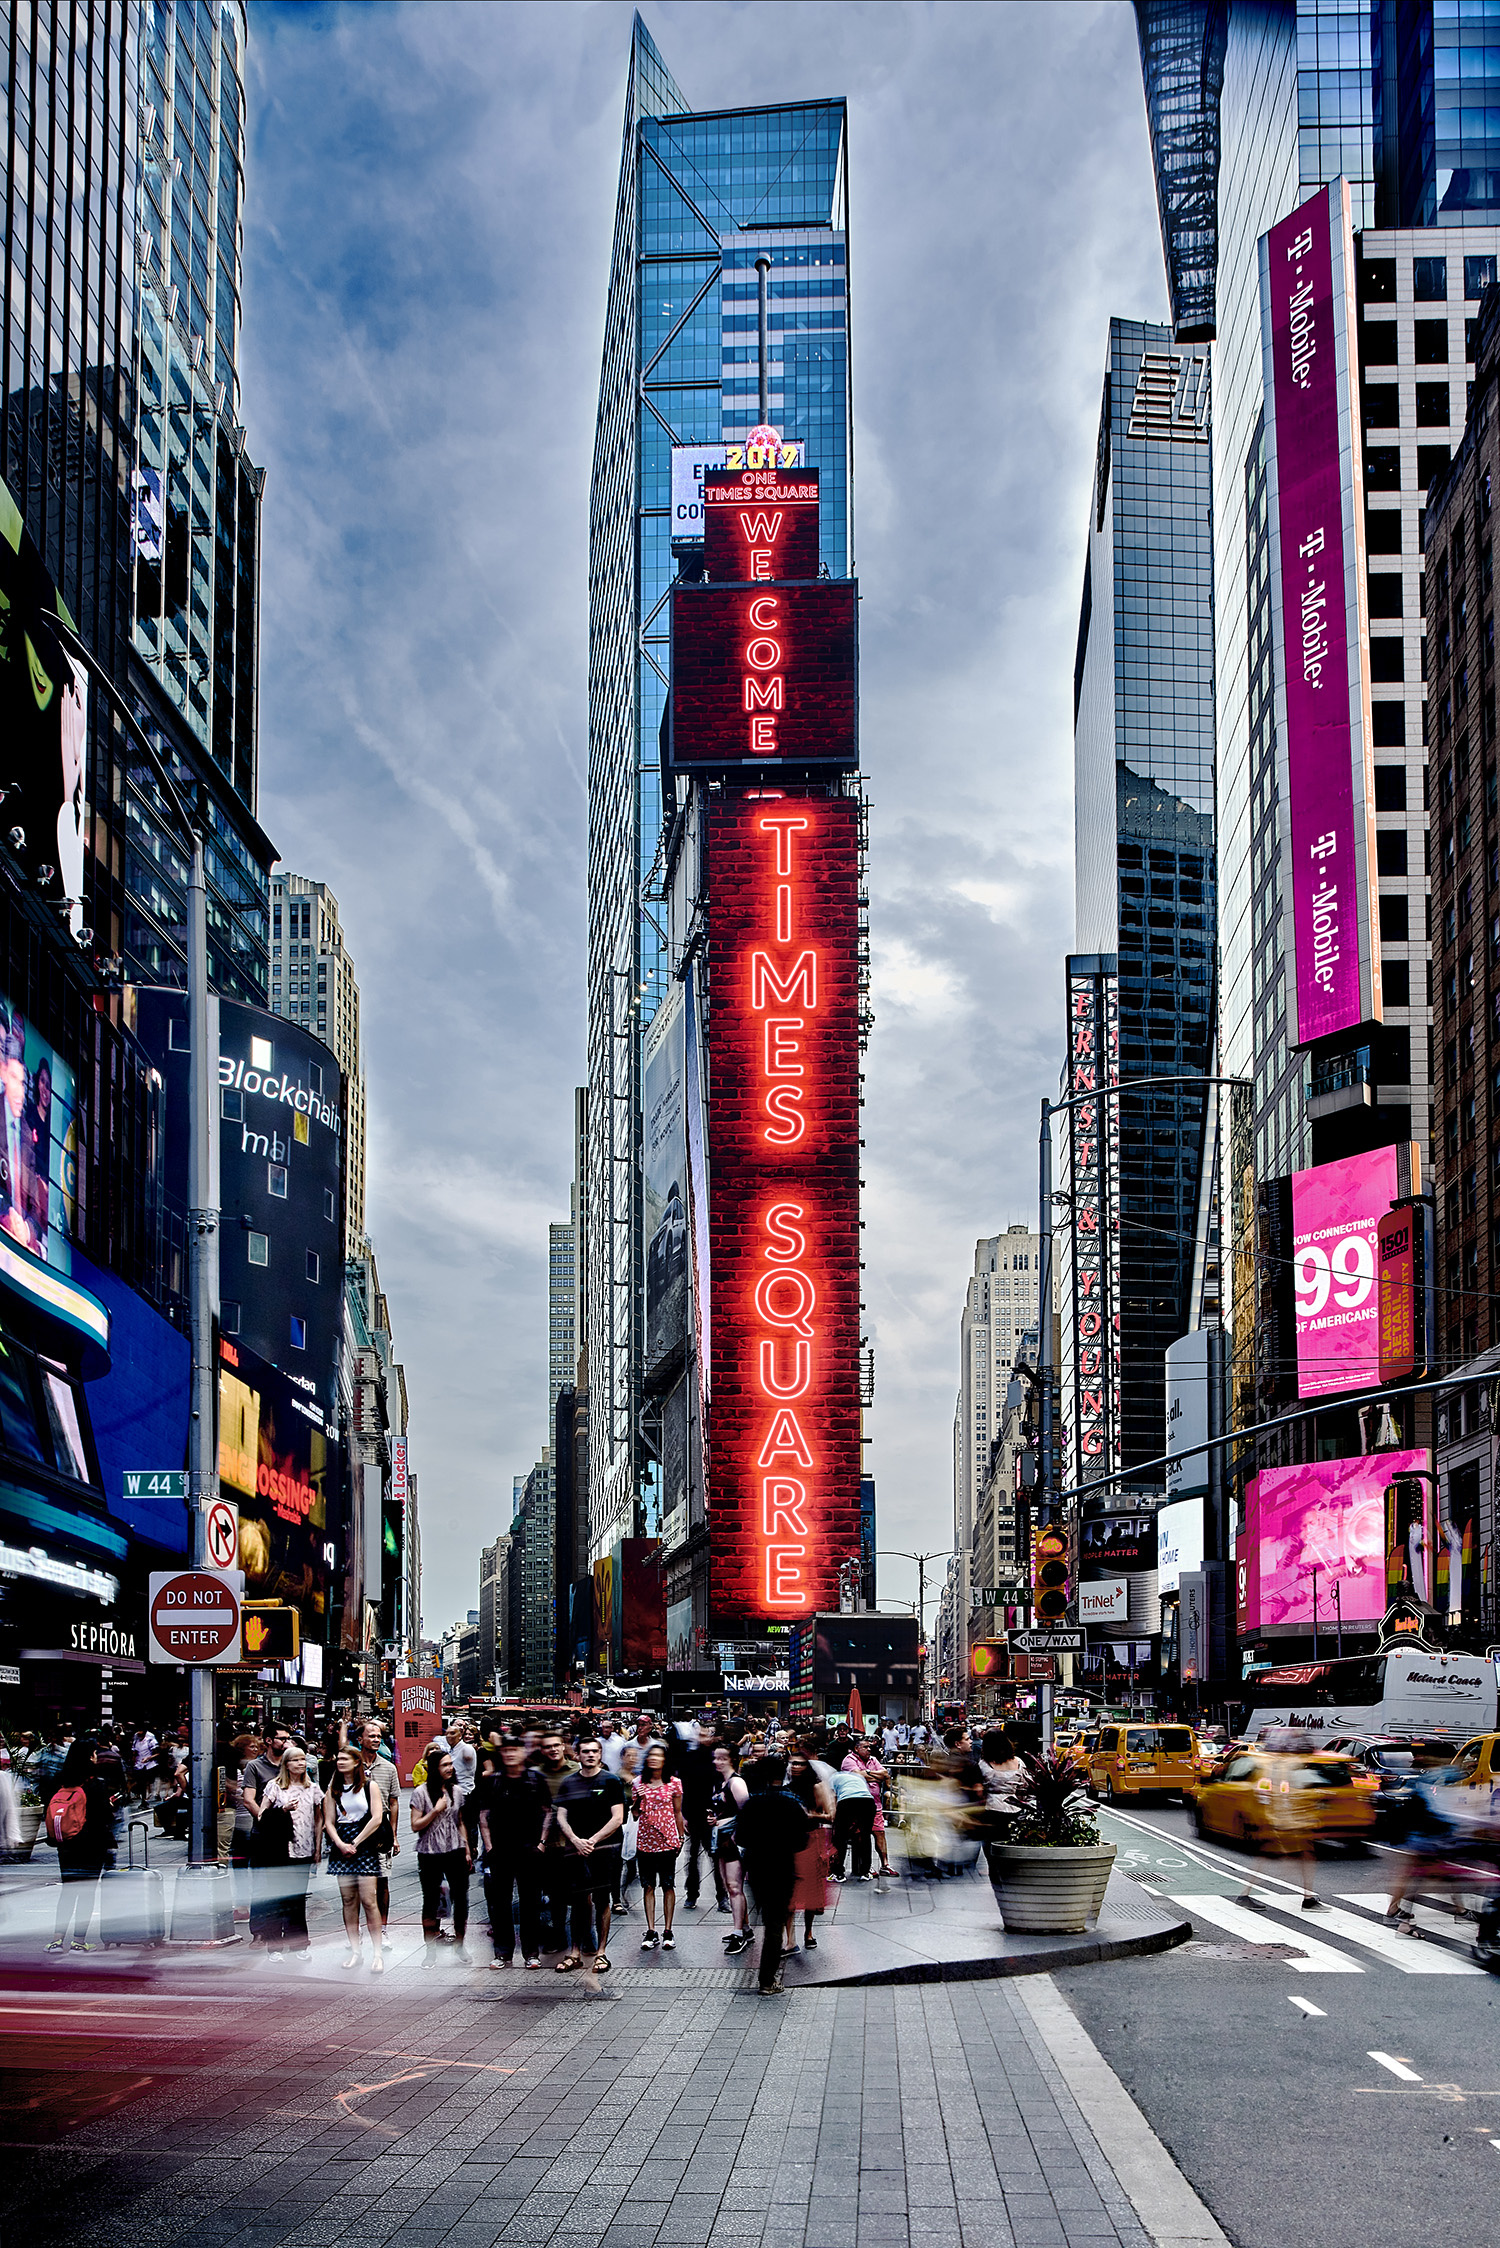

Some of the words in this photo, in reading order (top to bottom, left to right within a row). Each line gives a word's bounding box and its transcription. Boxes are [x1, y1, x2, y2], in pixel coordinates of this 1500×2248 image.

[742, 472, 777, 485] ONE
[706, 487, 753, 501] TIMES
[754, 485, 818, 500] SQUARE
[752, 818, 817, 1145] TIMES
[1075, 993, 1095, 1166] ERNST
[218, 1056, 342, 1136] Blockchain
[1077, 1206, 1097, 1231] &
[1312, 1217, 1376, 1241] CONNECTING
[1380, 1226, 1409, 1254] 1501
[1309, 1307, 1378, 1332] AMERICANS
[1382, 1269, 1392, 1364] FLAGSHIP
[1402, 1262, 1410, 1357] OPPORTUNITY
[1392, 1293, 1402, 1361] RETAIL
[1079, 1271, 1104, 1455] YOUNG
[755, 1203, 816, 1604] SQUARE
[393, 1442, 406, 1488] Locker
[127, 1475, 141, 1494] W
[147, 1475, 171, 1494] 44
[1104, 1549, 1139, 1557] MATTER
[166, 1591, 187, 1605] DO
[193, 1590, 223, 1604] NOT
[985, 1590, 996, 1604] W
[1002, 1590, 1019, 1604] 44
[1081, 1594, 1115, 1610] TriNet
[1348, 1622, 1373, 1631] REUTERS
[71, 1623, 136, 1657] SEPHORA
[170, 1630, 219, 1645] ENTER
[1020, 1636, 1042, 1646] ONE
[1052, 1636, 1076, 1646] WAY
[756, 1675, 790, 1691] YORK
[1448, 1674, 1483, 1686] Coach
[401, 1685, 429, 1701] DESIGN
[401, 1697, 436, 1714] PAVILION
